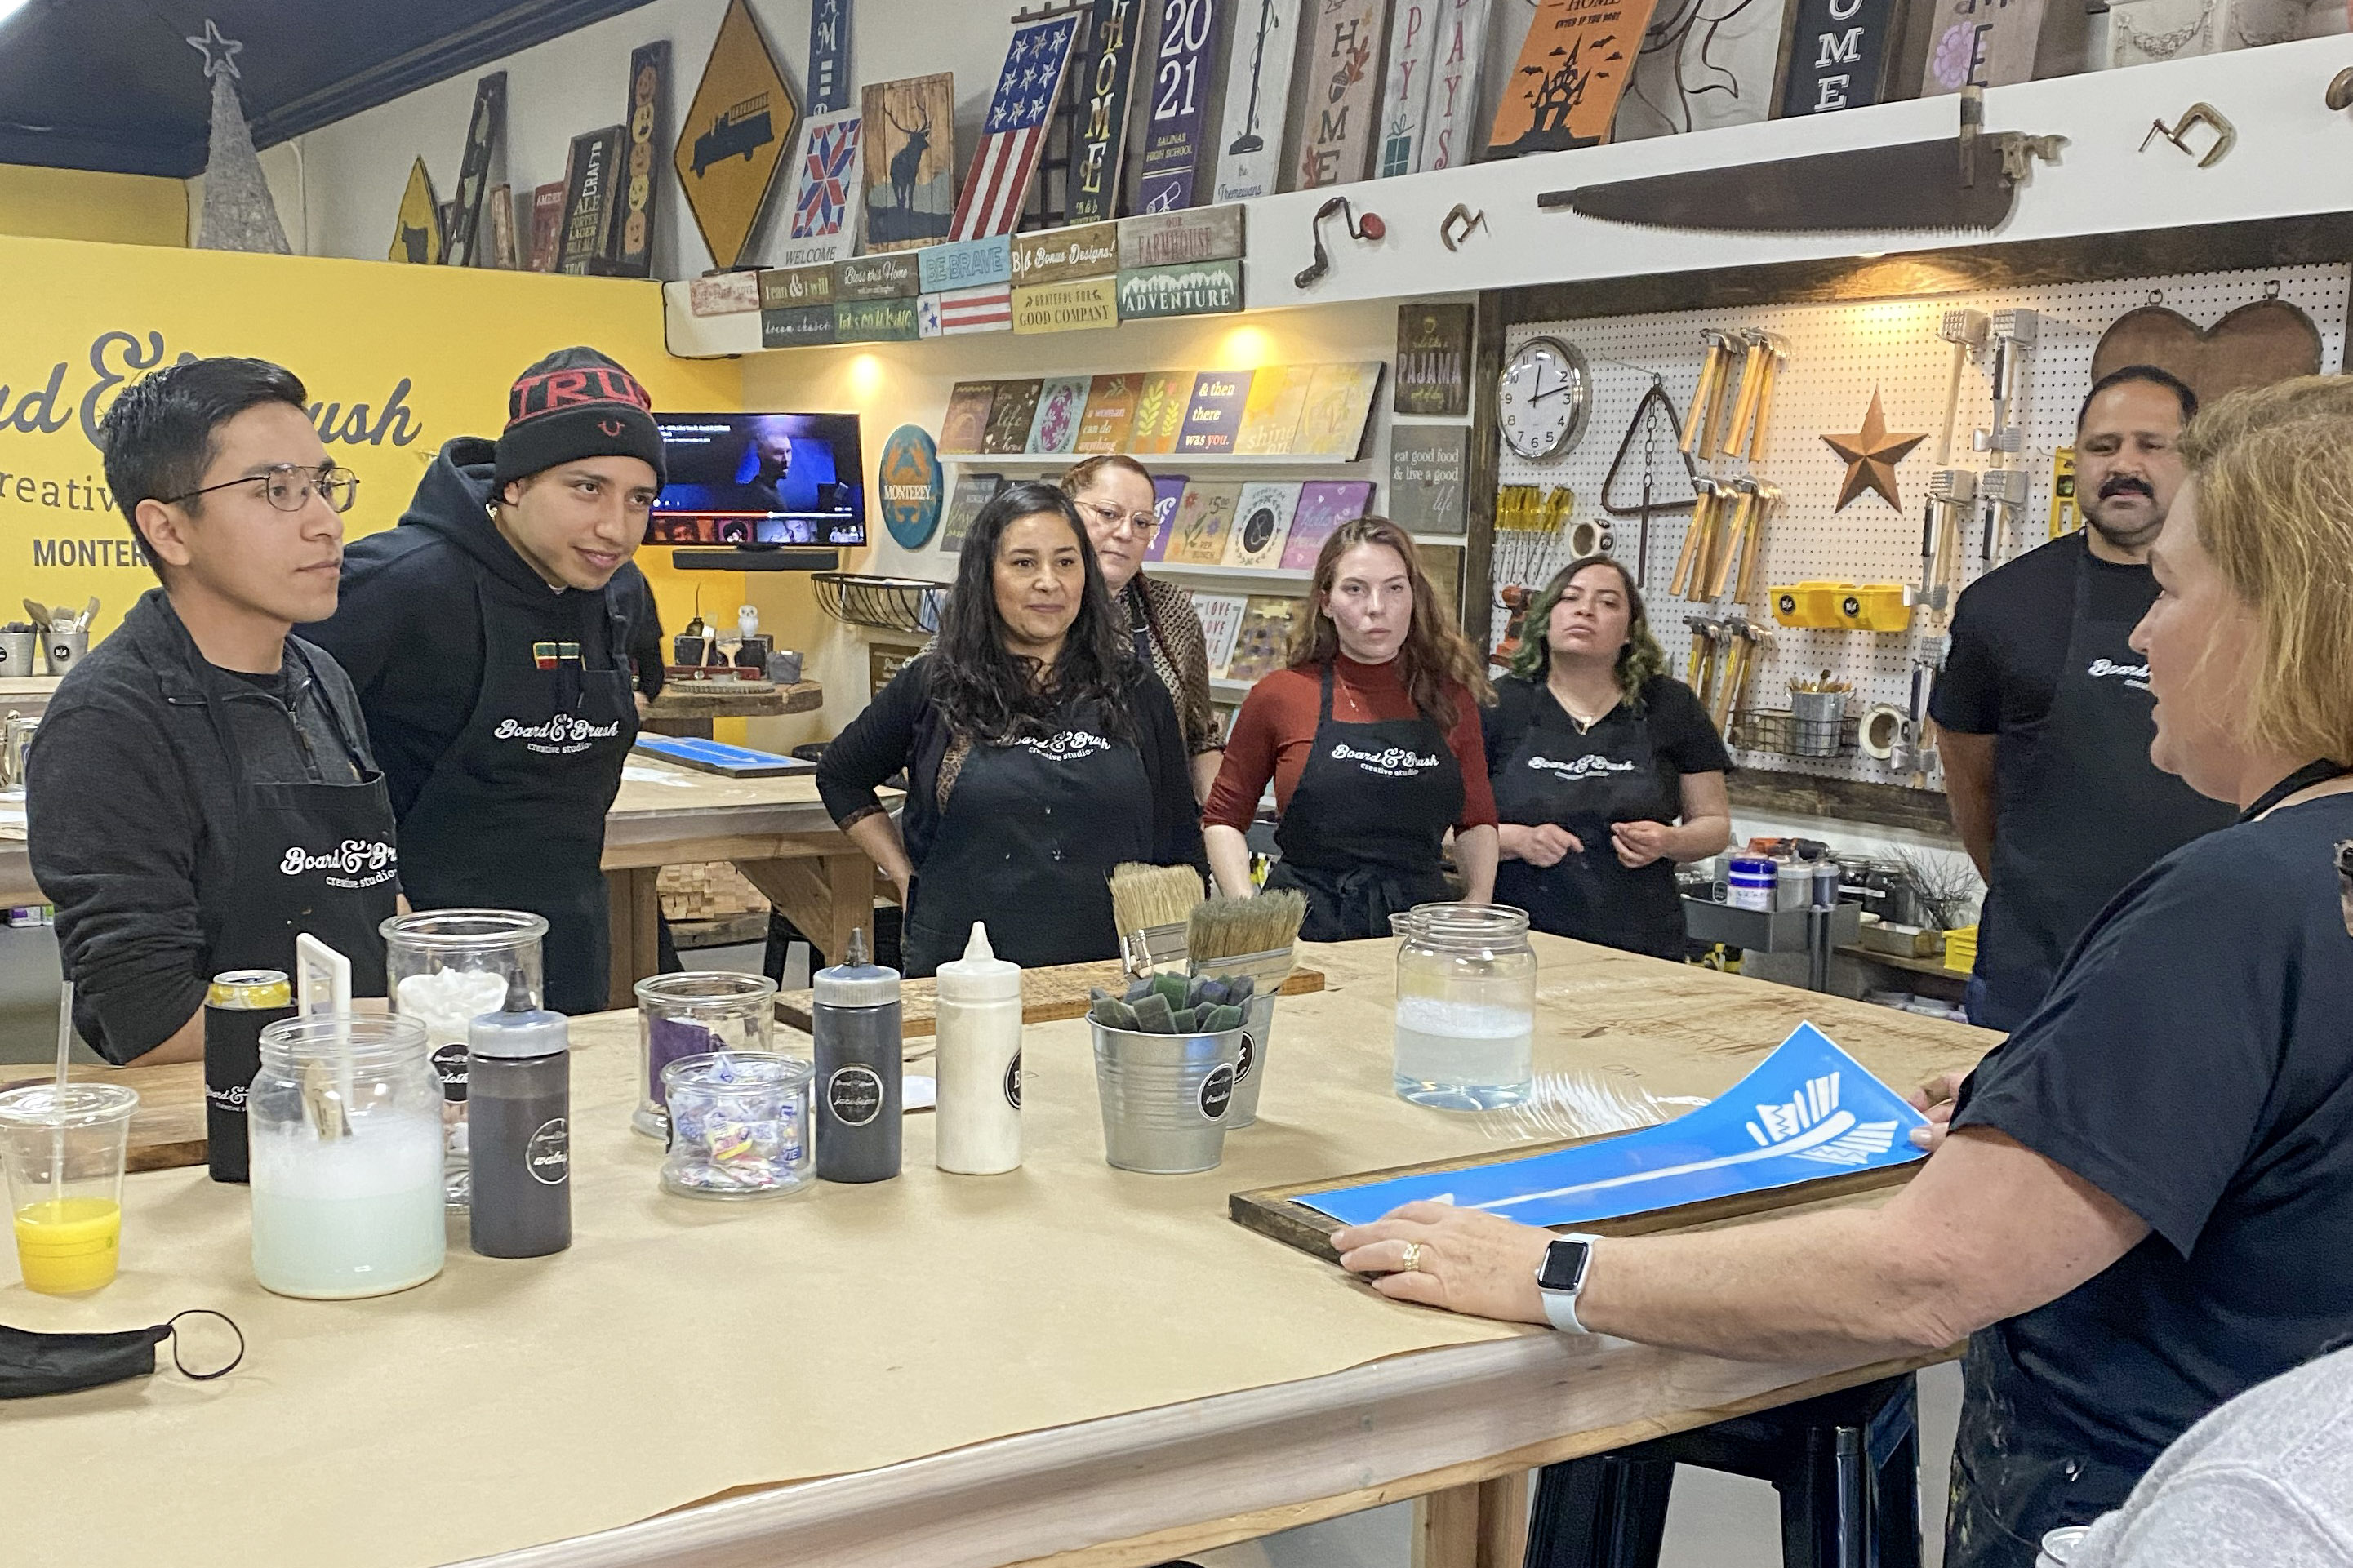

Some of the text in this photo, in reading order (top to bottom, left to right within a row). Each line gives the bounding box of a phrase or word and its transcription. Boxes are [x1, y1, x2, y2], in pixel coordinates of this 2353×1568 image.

[1161, 0, 1212, 57] 20
[1081, 0, 1130, 193] HOME
[1154, 56, 1199, 121] 21
[1166, 216, 1182, 227] OUR
[1138, 227, 1212, 263] FARMHOUSE
[785, 247, 837, 265] WELCOME
[1034, 247, 1066, 269] Bonus
[1069, 239, 1116, 264] Designs!
[927, 247, 1003, 282] BE BRAVE
[790, 273, 803, 297] &
[810, 277, 829, 295] will
[1035, 290, 1092, 306] GRATEFUL FOR
[1126, 288, 1230, 312] ADVENTURE
[1020, 304, 1110, 327] GOOD COMPANY
[1397, 352, 1461, 384] PAJAMA
[1559, 371, 1568, 383] 2
[1199, 380, 1235, 397] & then
[1505, 393, 1513, 405] 9
[1562, 393, 1571, 405] 3
[1094, 408, 1125, 418] woman
[1192, 406, 1221, 422] there
[1507, 415, 1516, 426] 8
[1557, 415, 1565, 427] 4
[1083, 420, 1112, 434] can do
[1185, 433, 1206, 446] was
[1531, 437, 1539, 449] 6
[1546, 431, 1555, 443] 5
[1394, 447, 1459, 466] eat good food
[1393, 465, 1459, 484] & live a good
[883, 485, 932, 501] MONTEREY
[1433, 485, 1455, 522] life
[1360, 762, 1393, 775] creative
